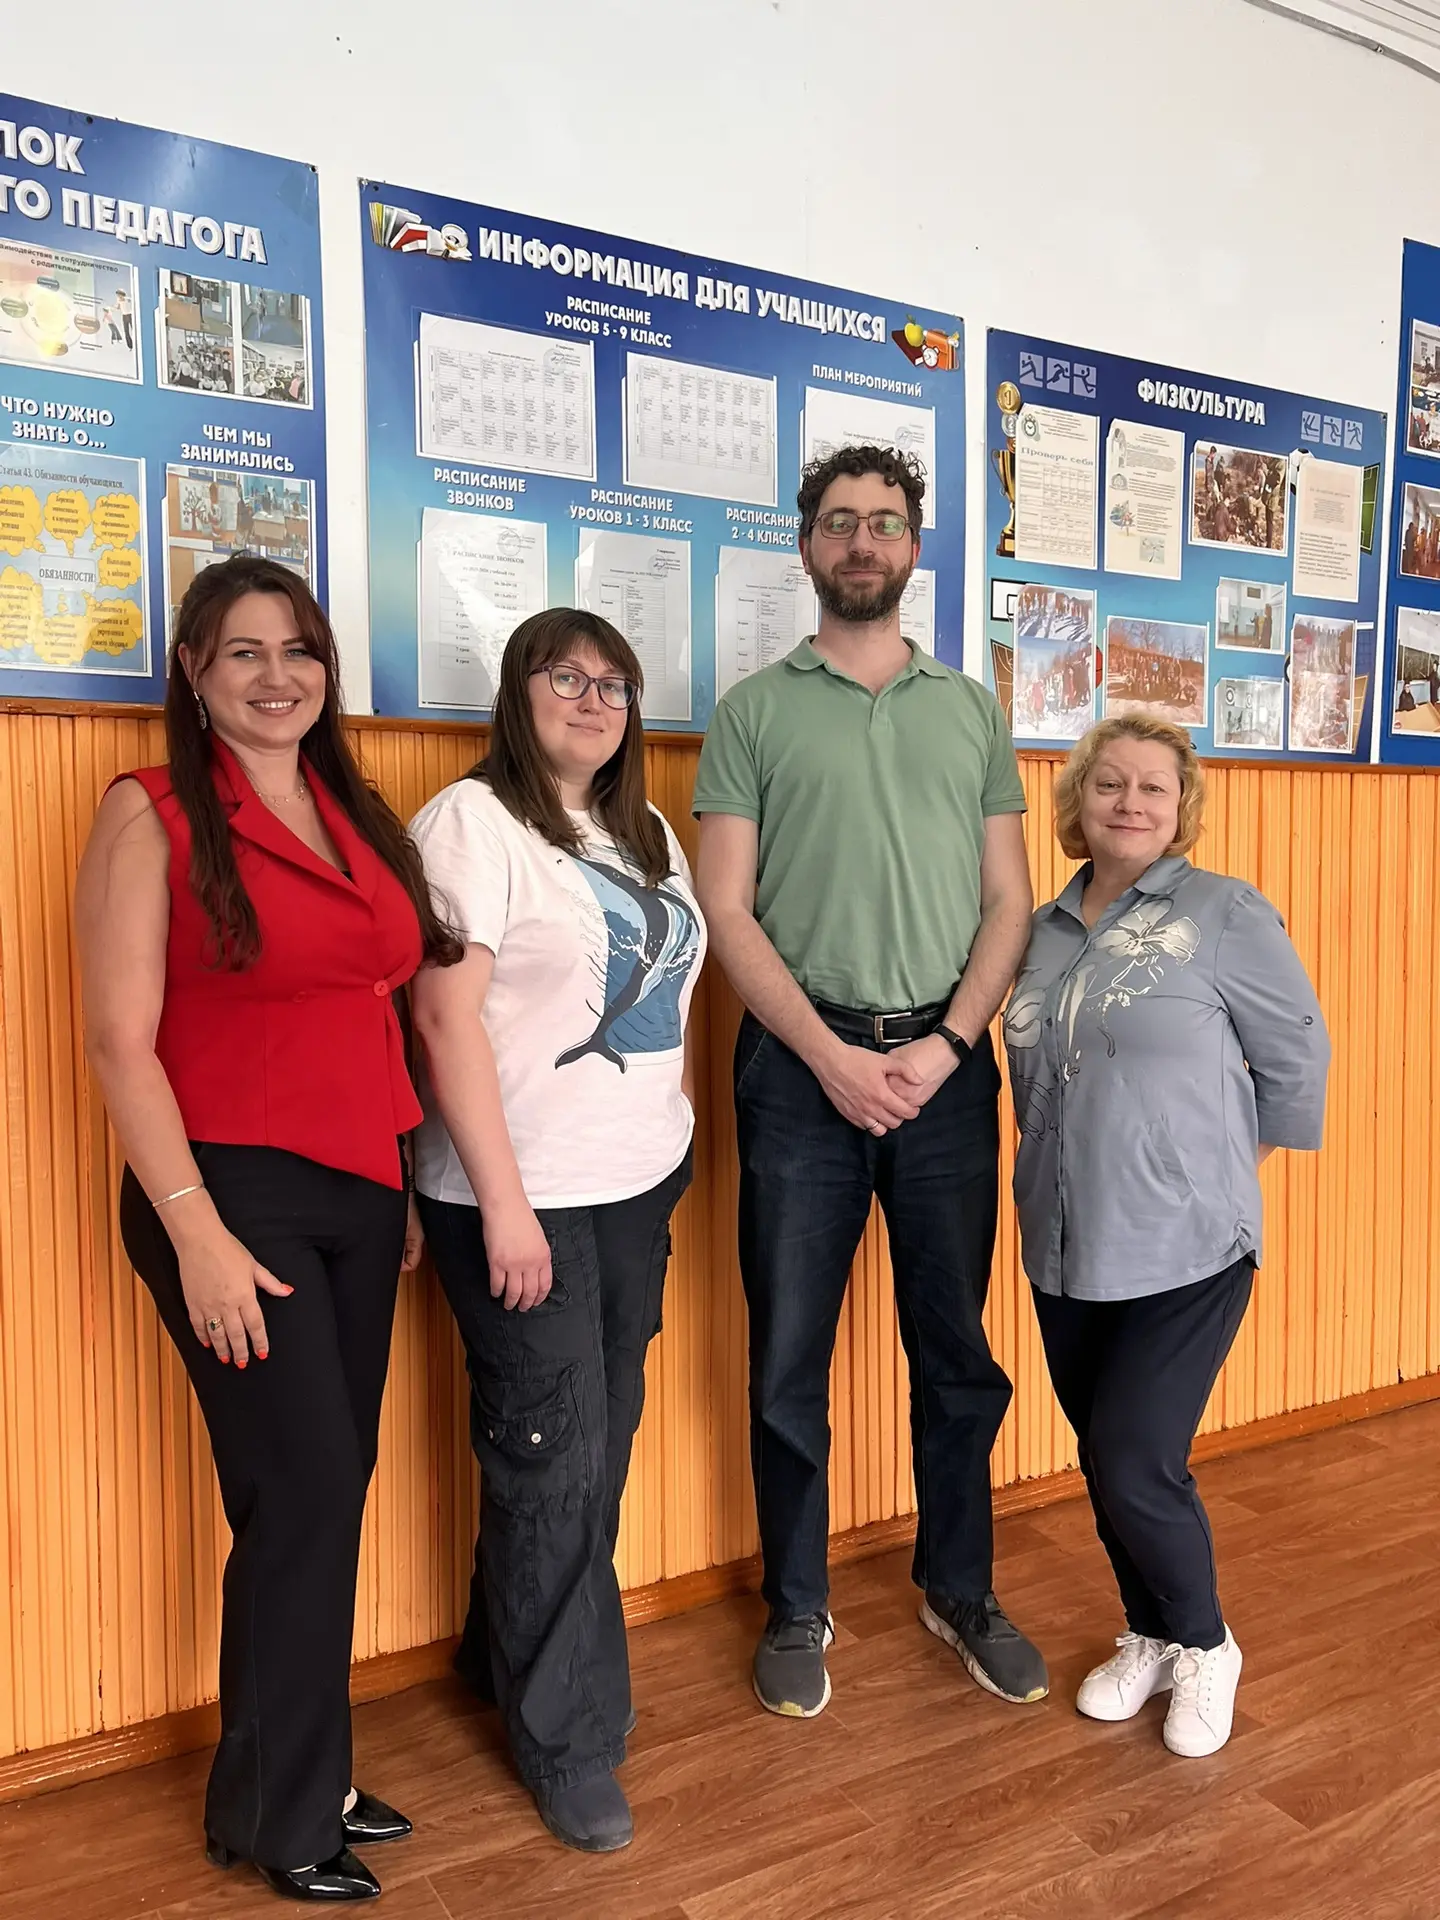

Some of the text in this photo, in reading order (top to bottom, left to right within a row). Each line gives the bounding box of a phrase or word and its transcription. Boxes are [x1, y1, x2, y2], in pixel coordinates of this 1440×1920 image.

[62, 187, 268, 264] ПЕДАГОГА
[37, 260, 81, 273] родителями
[61, 256, 119, 273] сотрудничество
[479, 227, 886, 343] ИНФОРМАЦИЯ ДЛЯ УЧАЩИХСЯ
[567, 296, 652, 325] РАСПИСАНИЕ
[545, 311, 600, 335] УРОКОВ
[603, 322, 610, 337] 5
[619, 325, 628, 340] 9
[630, 328, 672, 349] КЛАСС
[812, 364, 922, 398] ПЛАН МЕРОПРИЯТИЙ
[1004, 389, 1012, 406] 1
[1137, 378, 1267, 426] ФИЗКУЛЬТУРА
[1, 396, 114, 427] ЧТО НУЖНО
[12, 421, 106, 448] ЗНАТЬ О...
[202, 424, 272, 448] ЧЕМ МЫ
[180, 443, 295, 473] ЗАНИМАЛИСЬ
[1021, 447, 1094, 467] Проверь себя
[0, 464, 22, 477] Статья
[35, 469, 78, 484] Обязанности
[434, 467, 526, 492] РАСПИСАНИЕ
[446, 490, 515, 511] ЗВОНКОВ
[591, 489, 673, 512] РАСПИСАНИЕ
[569, 505, 623, 526] УРОКОВ
[626, 512, 633, 526] 1
[642, 514, 650, 528] 3
[652, 516, 693, 534] КЛАСС
[726, 507, 800, 529] РАСПИСАНИЕ
[731, 527, 739, 540] 2
[747, 528, 755, 542] 4
[757, 528, 794, 546] КЛАСС
[496, 555, 525, 564] ЗВОНКОВ
